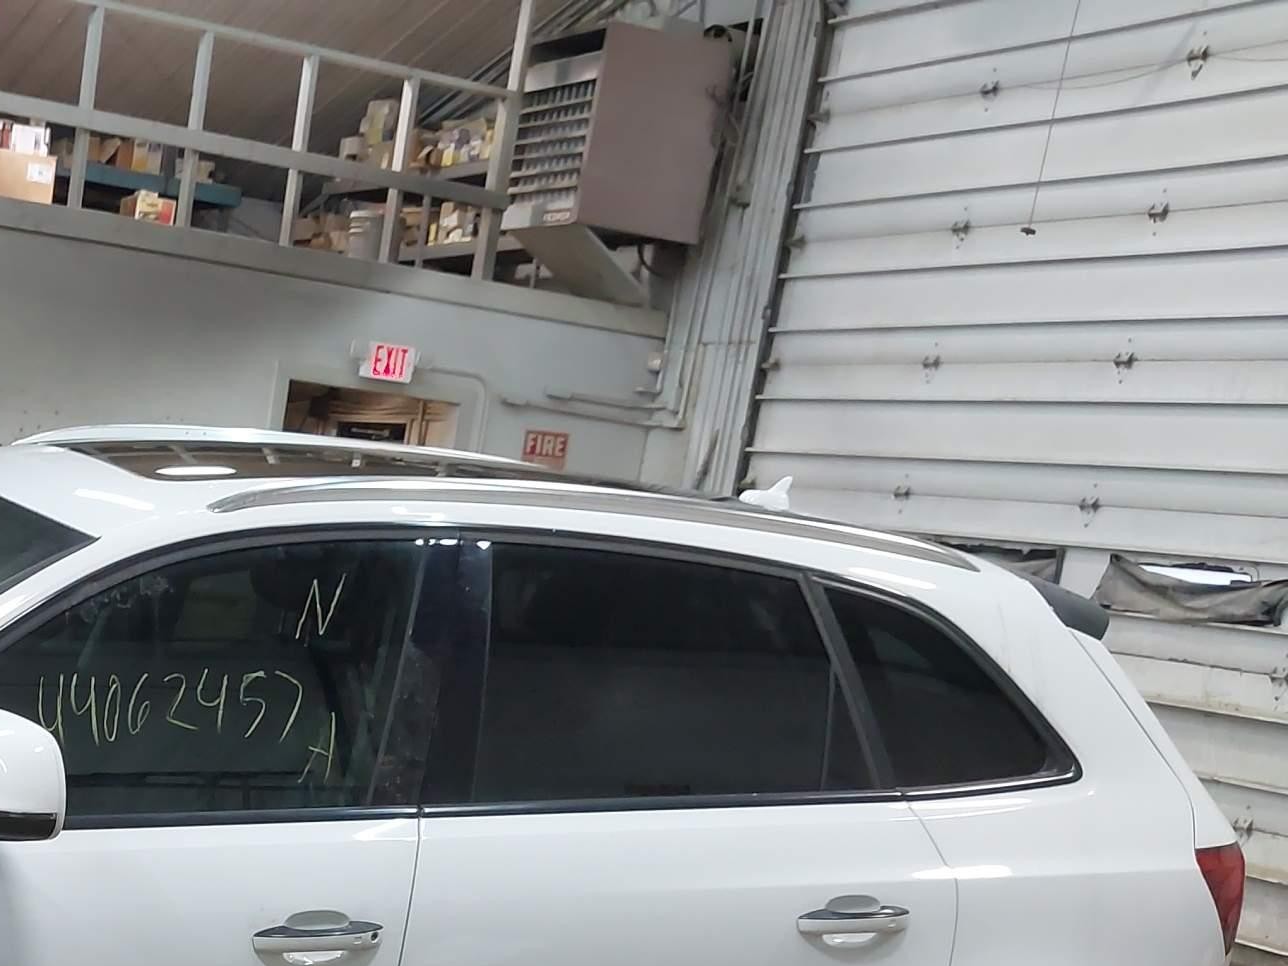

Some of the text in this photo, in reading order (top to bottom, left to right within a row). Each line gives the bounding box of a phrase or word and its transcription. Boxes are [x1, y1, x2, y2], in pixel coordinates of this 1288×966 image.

[372, 345, 409, 377] EXIT
[525, 432, 567, 457] FIRE
[296, 572, 347, 640] N
[38, 668, 303, 747] 44062457
